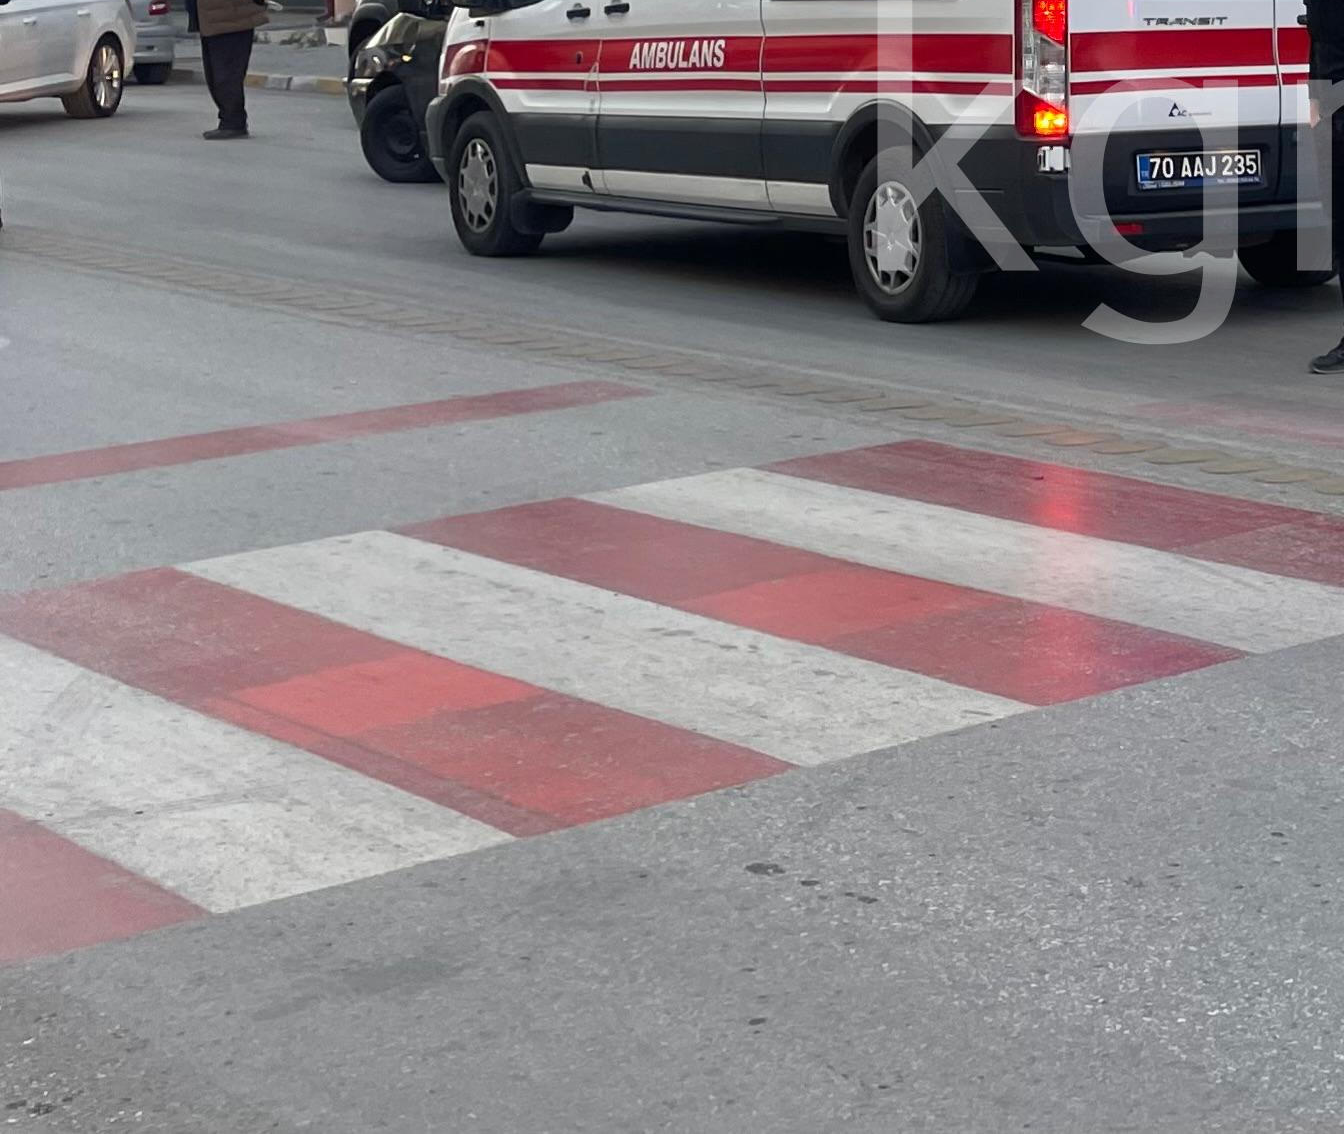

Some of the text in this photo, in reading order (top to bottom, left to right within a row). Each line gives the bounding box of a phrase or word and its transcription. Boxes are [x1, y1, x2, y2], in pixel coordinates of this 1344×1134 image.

[1143, 16, 1228, 26] TRANSIT
[629, 39, 725, 70] AMBULANS
[1150, 157, 1174, 179] 70
[1181, 156, 1217, 178] AAJ
[1221, 153, 1257, 175] 235
